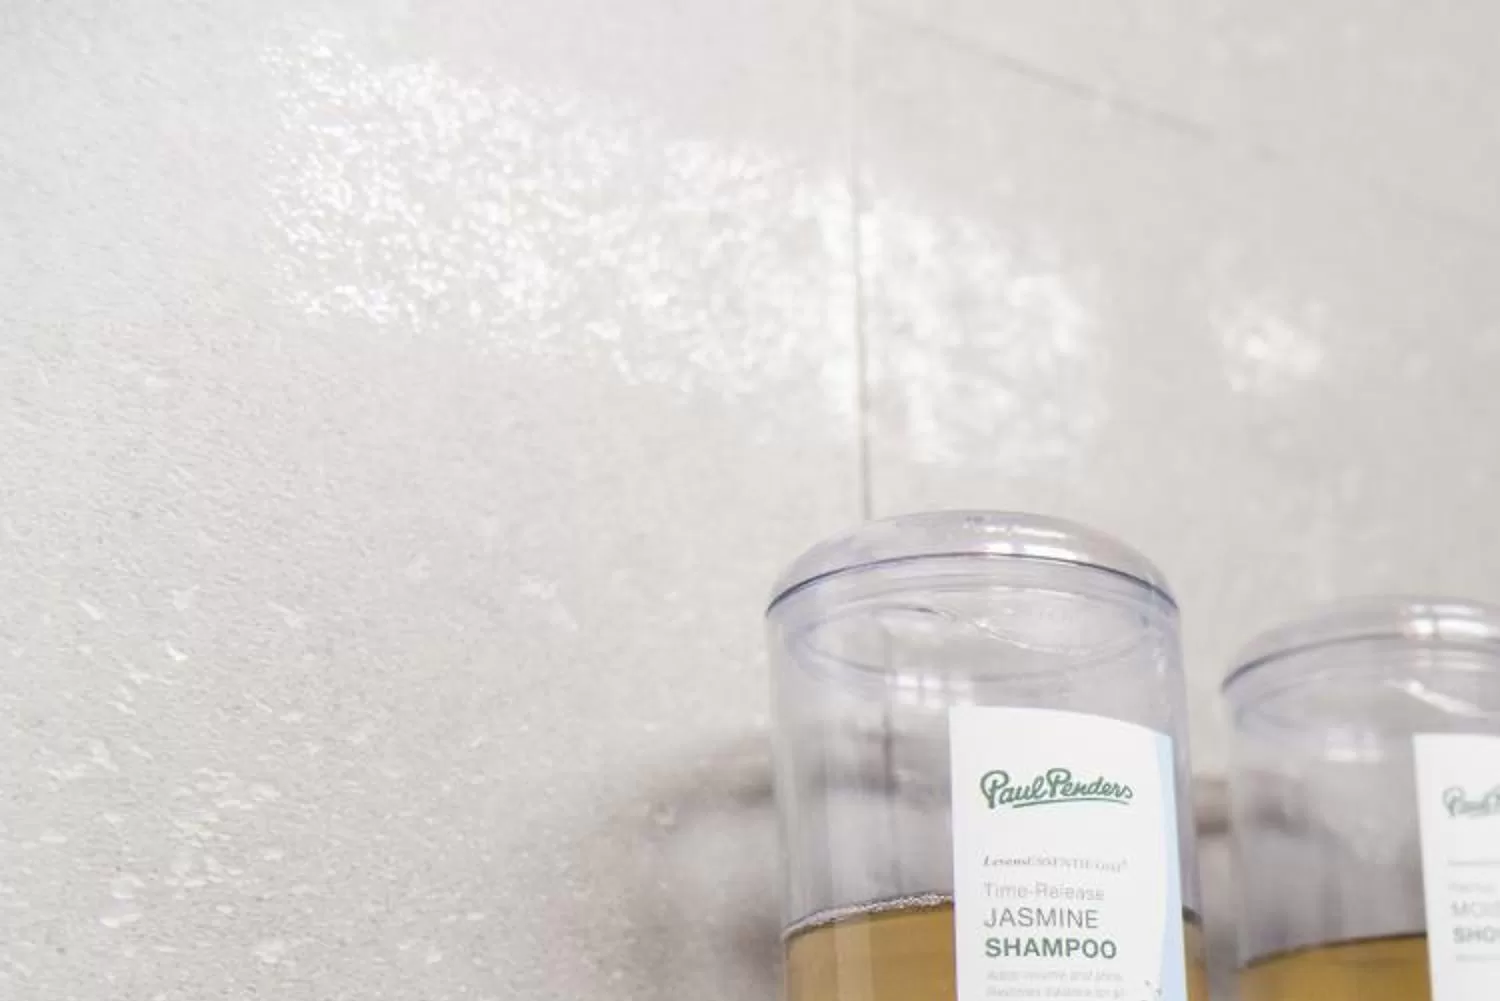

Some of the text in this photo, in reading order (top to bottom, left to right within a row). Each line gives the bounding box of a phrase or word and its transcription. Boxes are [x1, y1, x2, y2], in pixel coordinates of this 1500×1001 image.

[980, 767, 1133, 809] Paul Penders
[984, 881, 1105, 901] Time-Release
[984, 907, 1100, 929] JASMINE
[985, 937, 1117, 959] SHAMPOO
